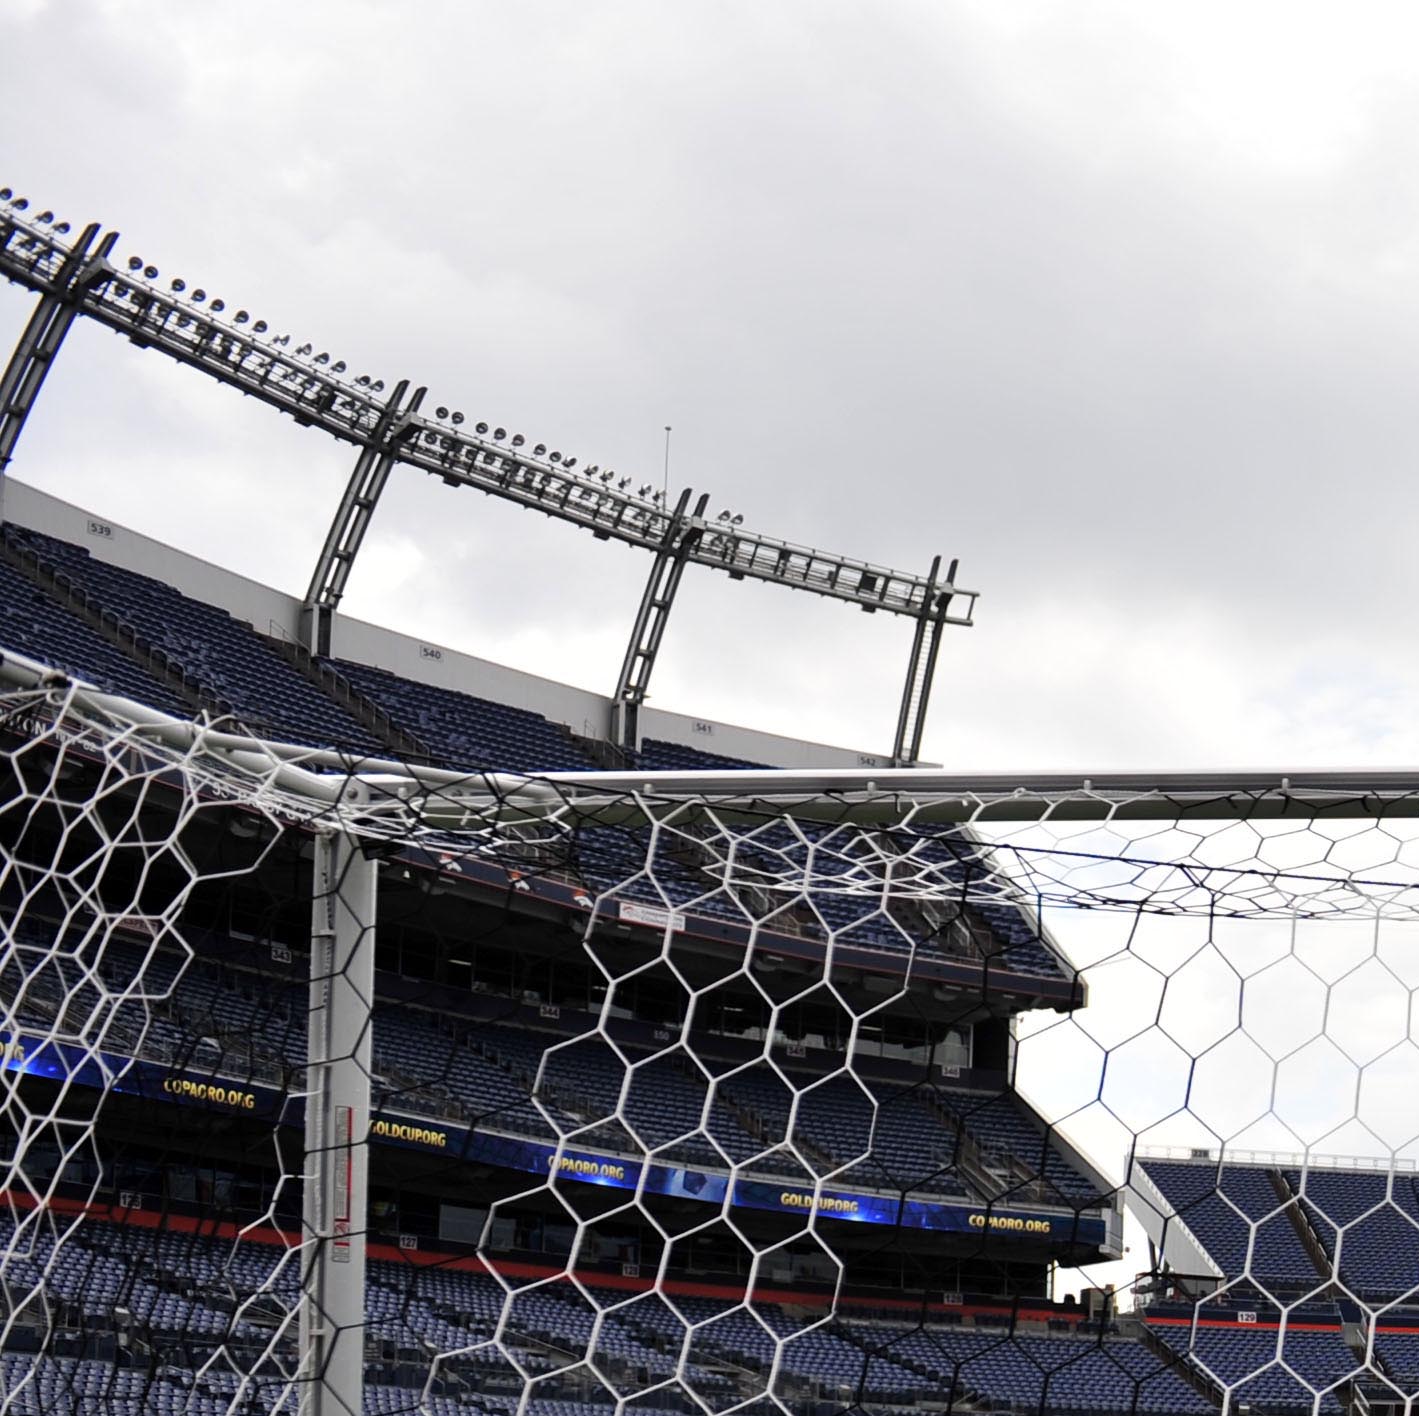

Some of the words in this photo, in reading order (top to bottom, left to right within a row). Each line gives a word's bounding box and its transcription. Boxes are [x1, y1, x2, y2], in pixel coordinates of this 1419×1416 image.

[91, 522, 112, 537] 539
[423, 647, 442, 660] 540
[696, 723, 712, 733] 541
[781, 1192, 859, 1213] GOLDUP.ORG
[401, 1236, 416, 1247] 127
